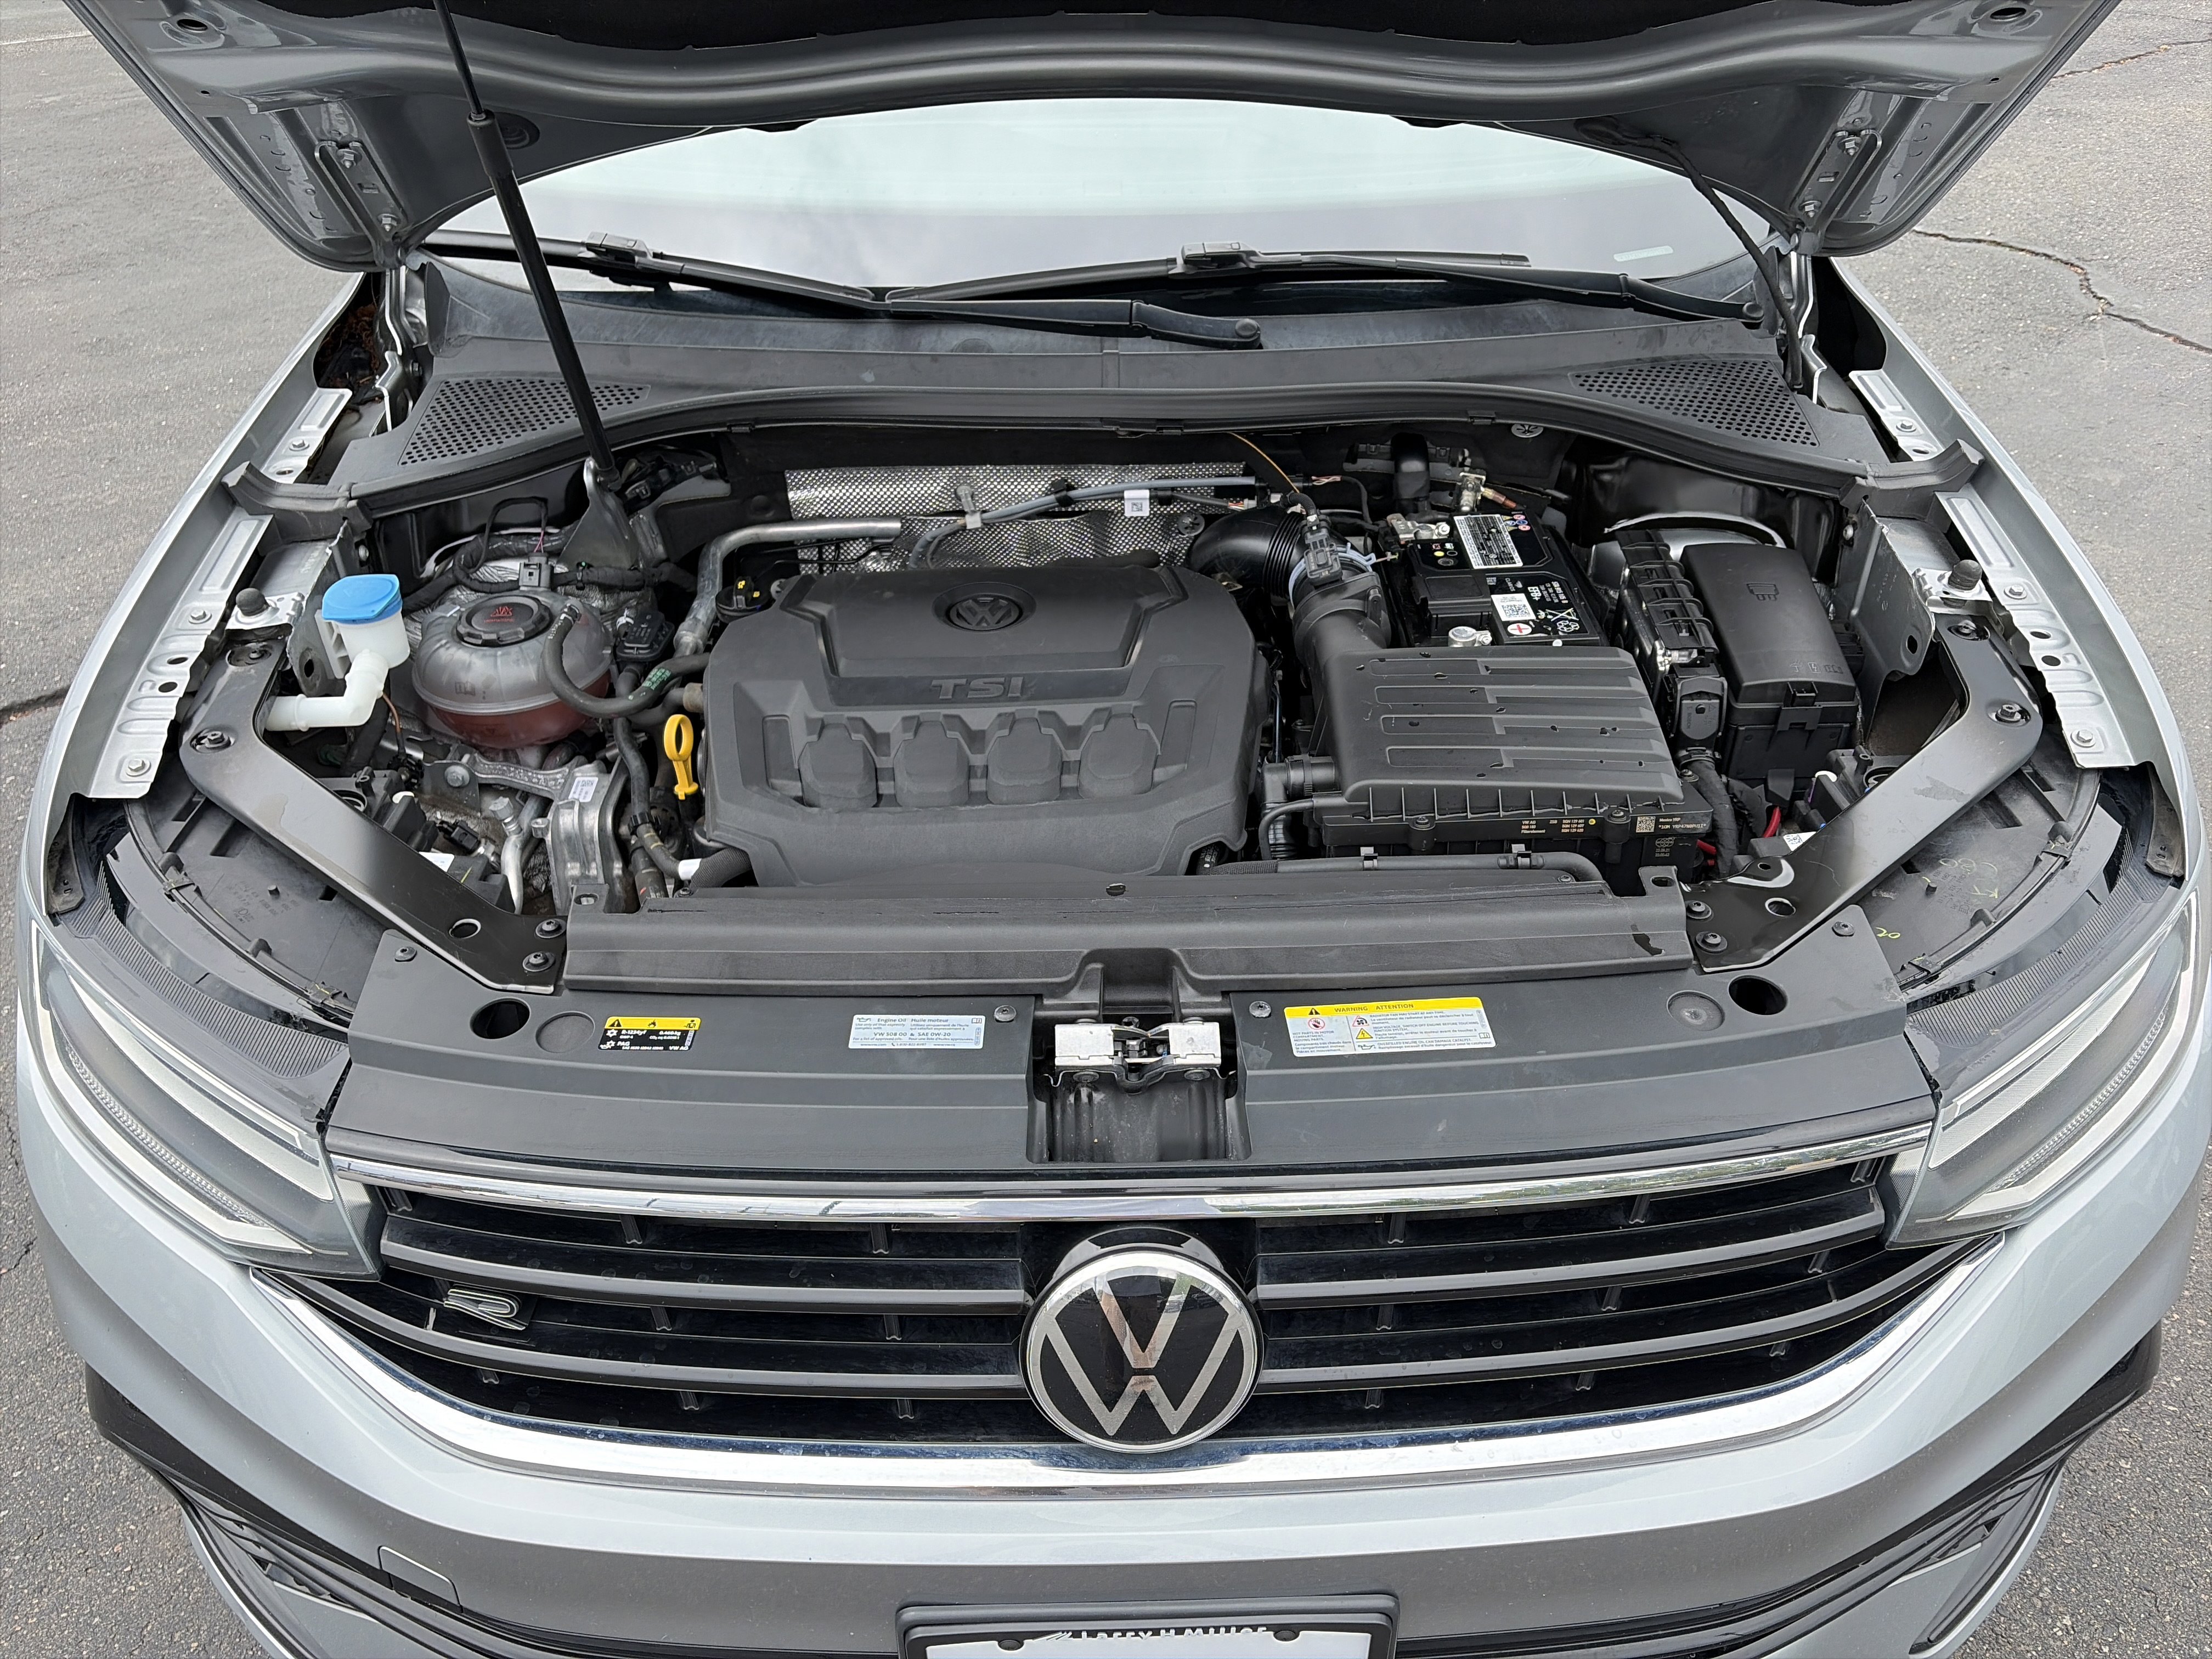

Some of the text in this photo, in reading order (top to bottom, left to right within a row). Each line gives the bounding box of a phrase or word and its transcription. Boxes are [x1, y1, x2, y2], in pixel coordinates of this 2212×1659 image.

[1528, 586, 1542, 601] EFB+
[932, 676, 1024, 699] TSI
[1034, 1262, 1252, 1443] VW
[1081, 1626, 1267, 1640] Larry H Miller
